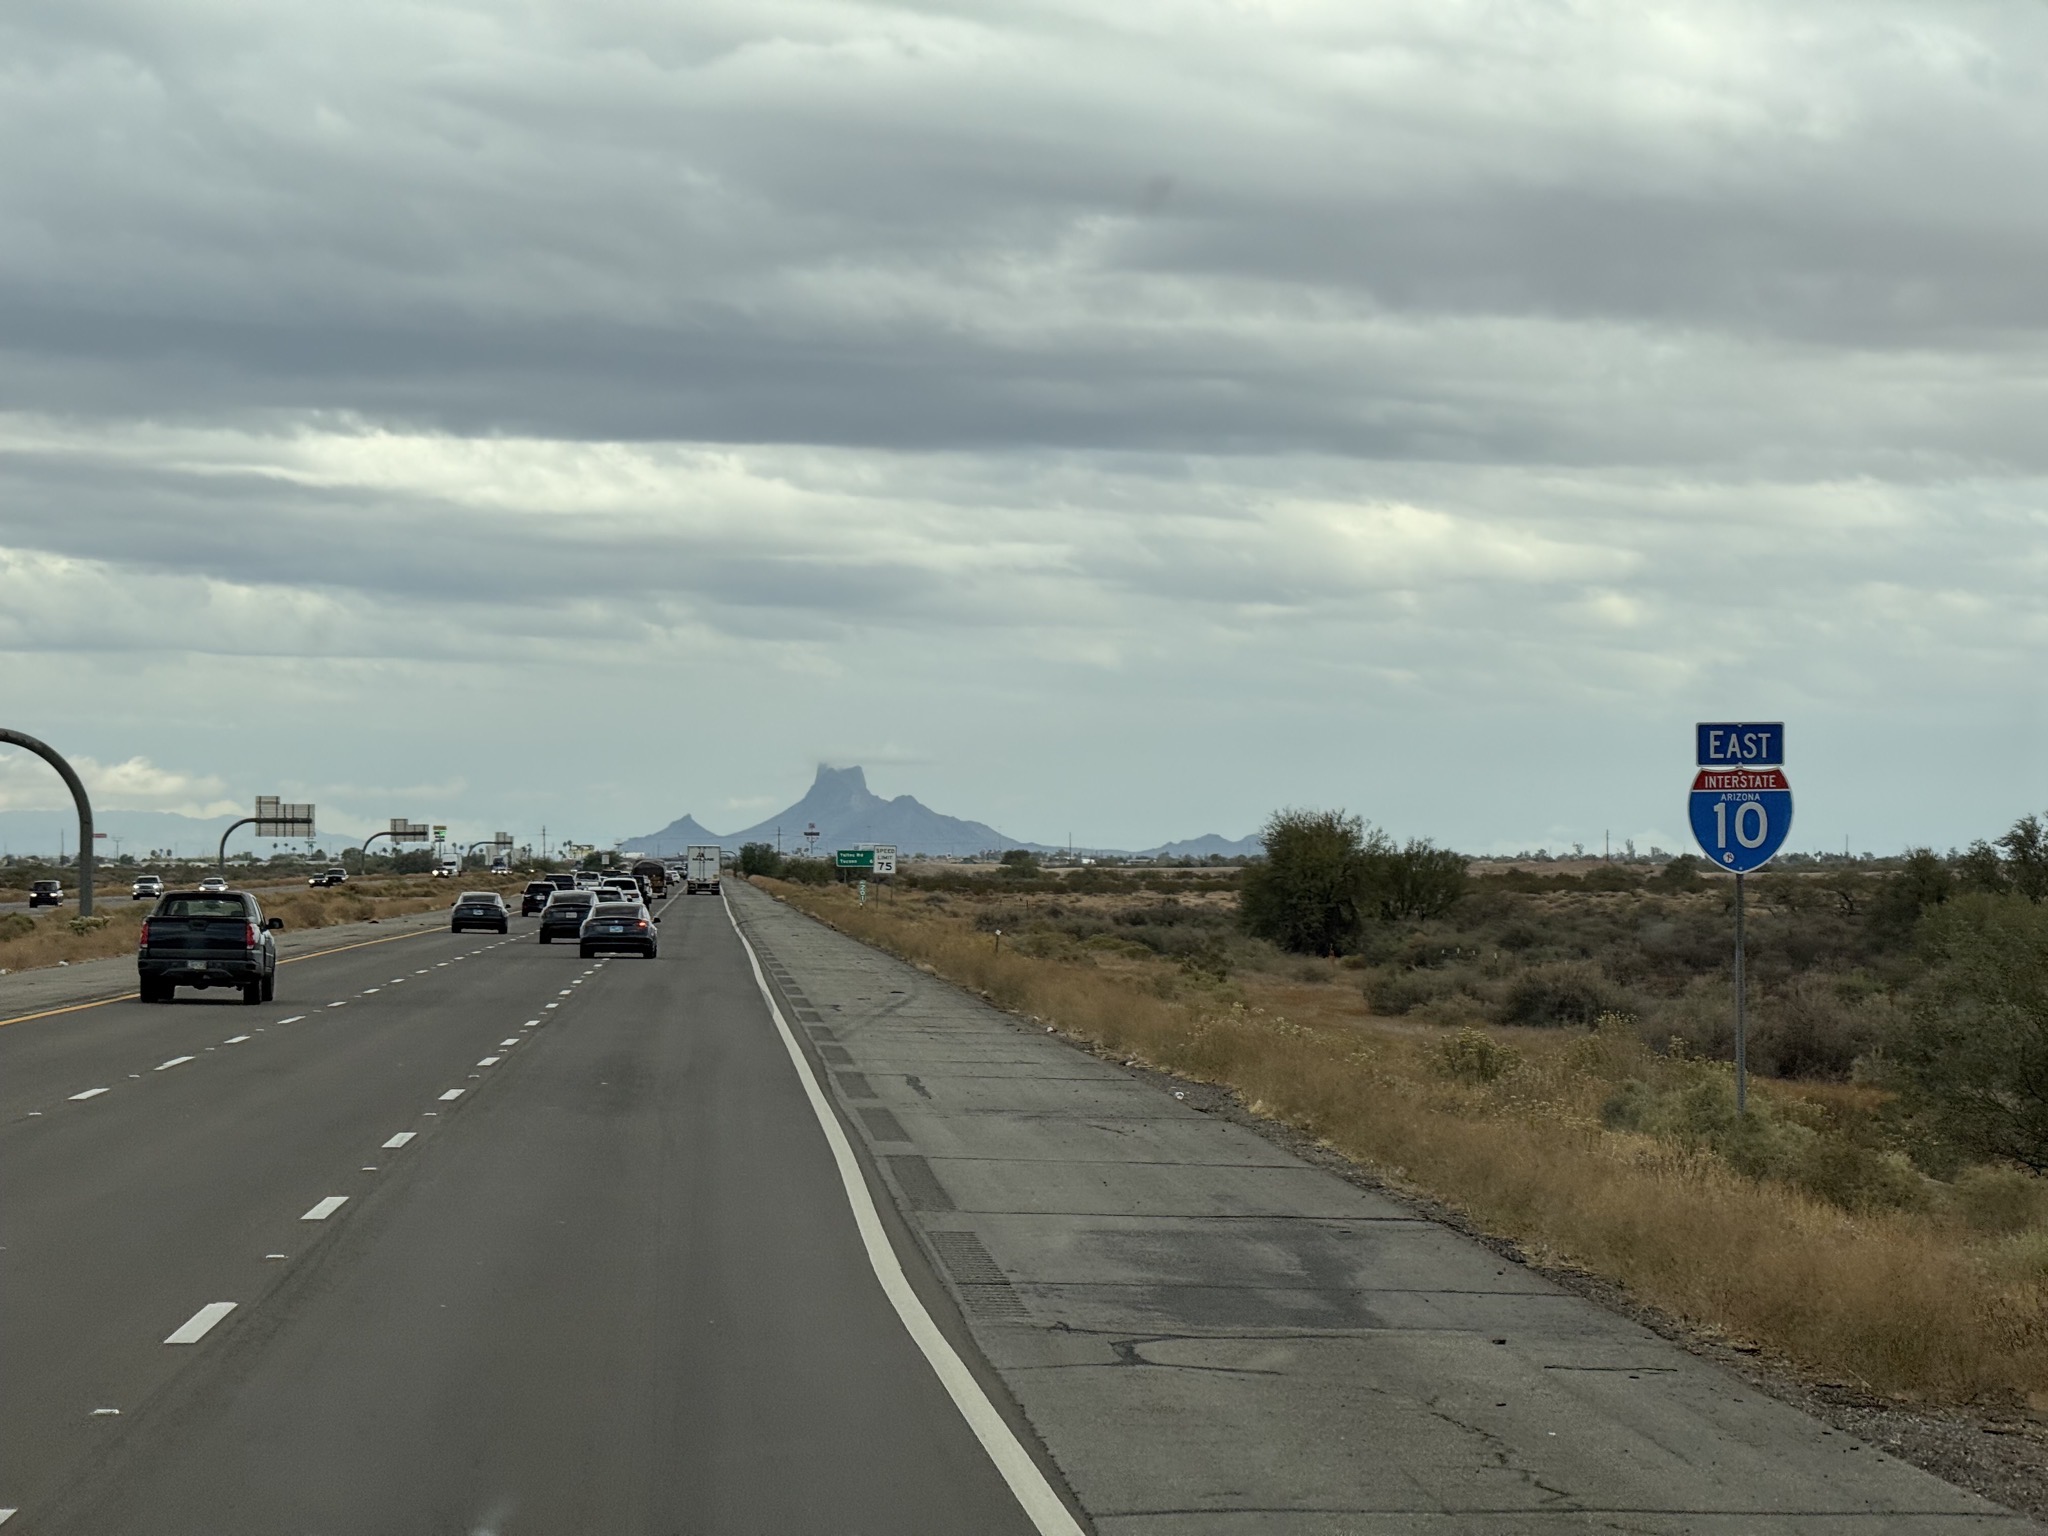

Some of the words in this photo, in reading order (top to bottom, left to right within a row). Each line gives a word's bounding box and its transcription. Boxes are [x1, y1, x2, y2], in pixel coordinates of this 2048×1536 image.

[1709, 730, 1772, 759] EAST
[1704, 775, 1777, 789] INTERSTATE
[1720, 793, 1761, 801] ARIZONA
[1713, 801, 1768, 849] 10
[877, 862, 893, 871] 75
